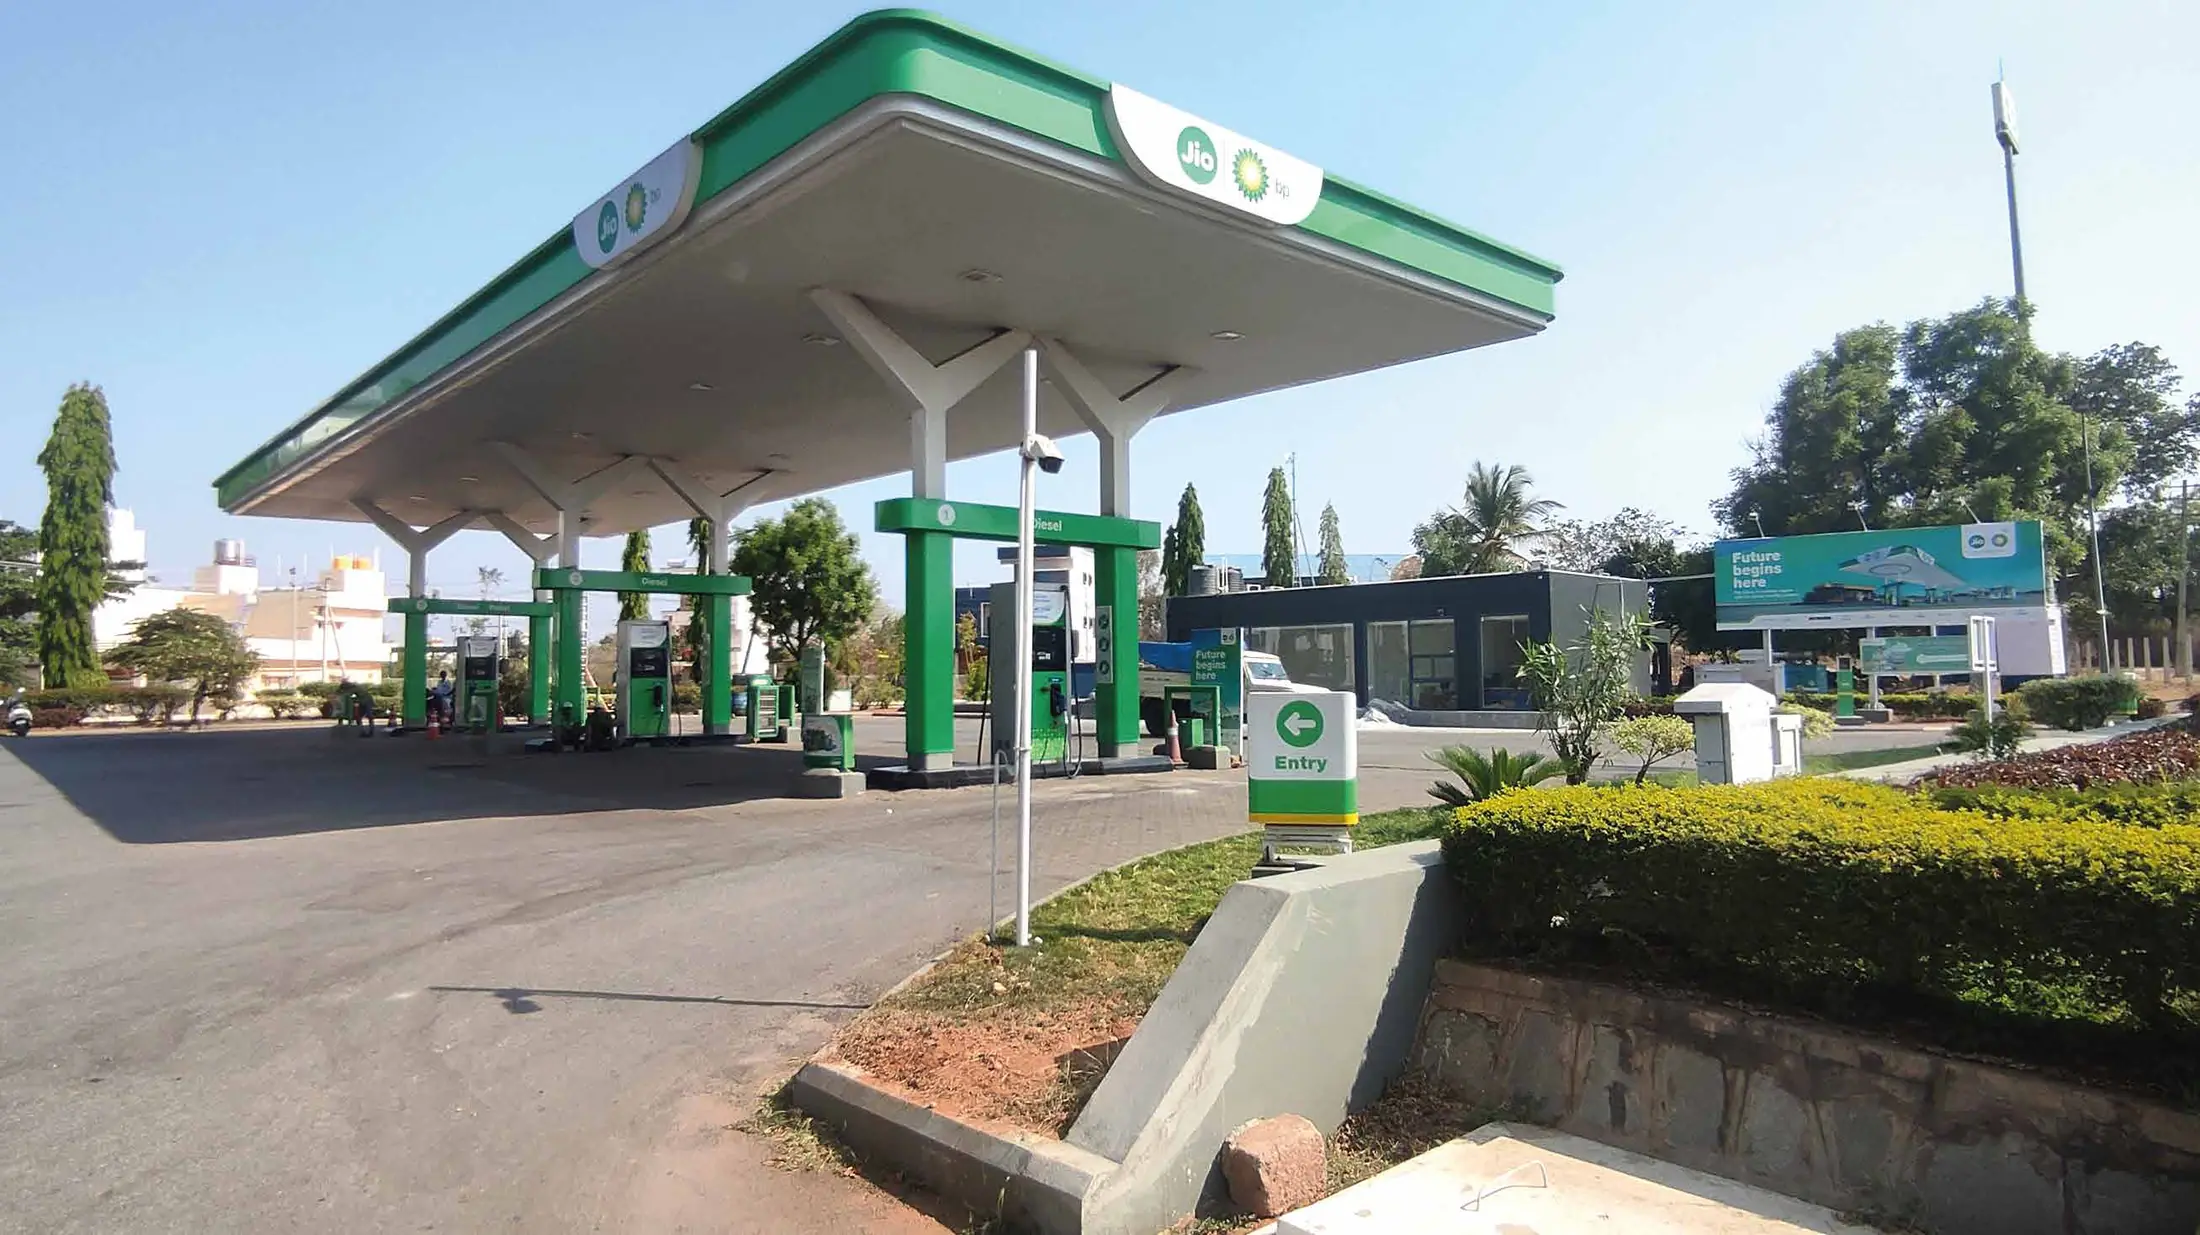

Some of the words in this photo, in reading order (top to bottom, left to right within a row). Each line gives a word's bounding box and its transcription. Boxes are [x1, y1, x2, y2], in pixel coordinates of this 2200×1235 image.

[1180, 140, 1215, 172] Jio
[1275, 178, 1290, 199] bp
[601, 216, 617, 241] Jio
[1732, 551, 1781, 563] Future
[1733, 563, 1782, 577] begins
[1734, 577, 1767, 588] here
[1196, 650, 1226, 660] Future
[1196, 660, 1226, 671] begins
[1196, 671, 1217, 680] here
[1275, 755, 1328, 773] Entry
